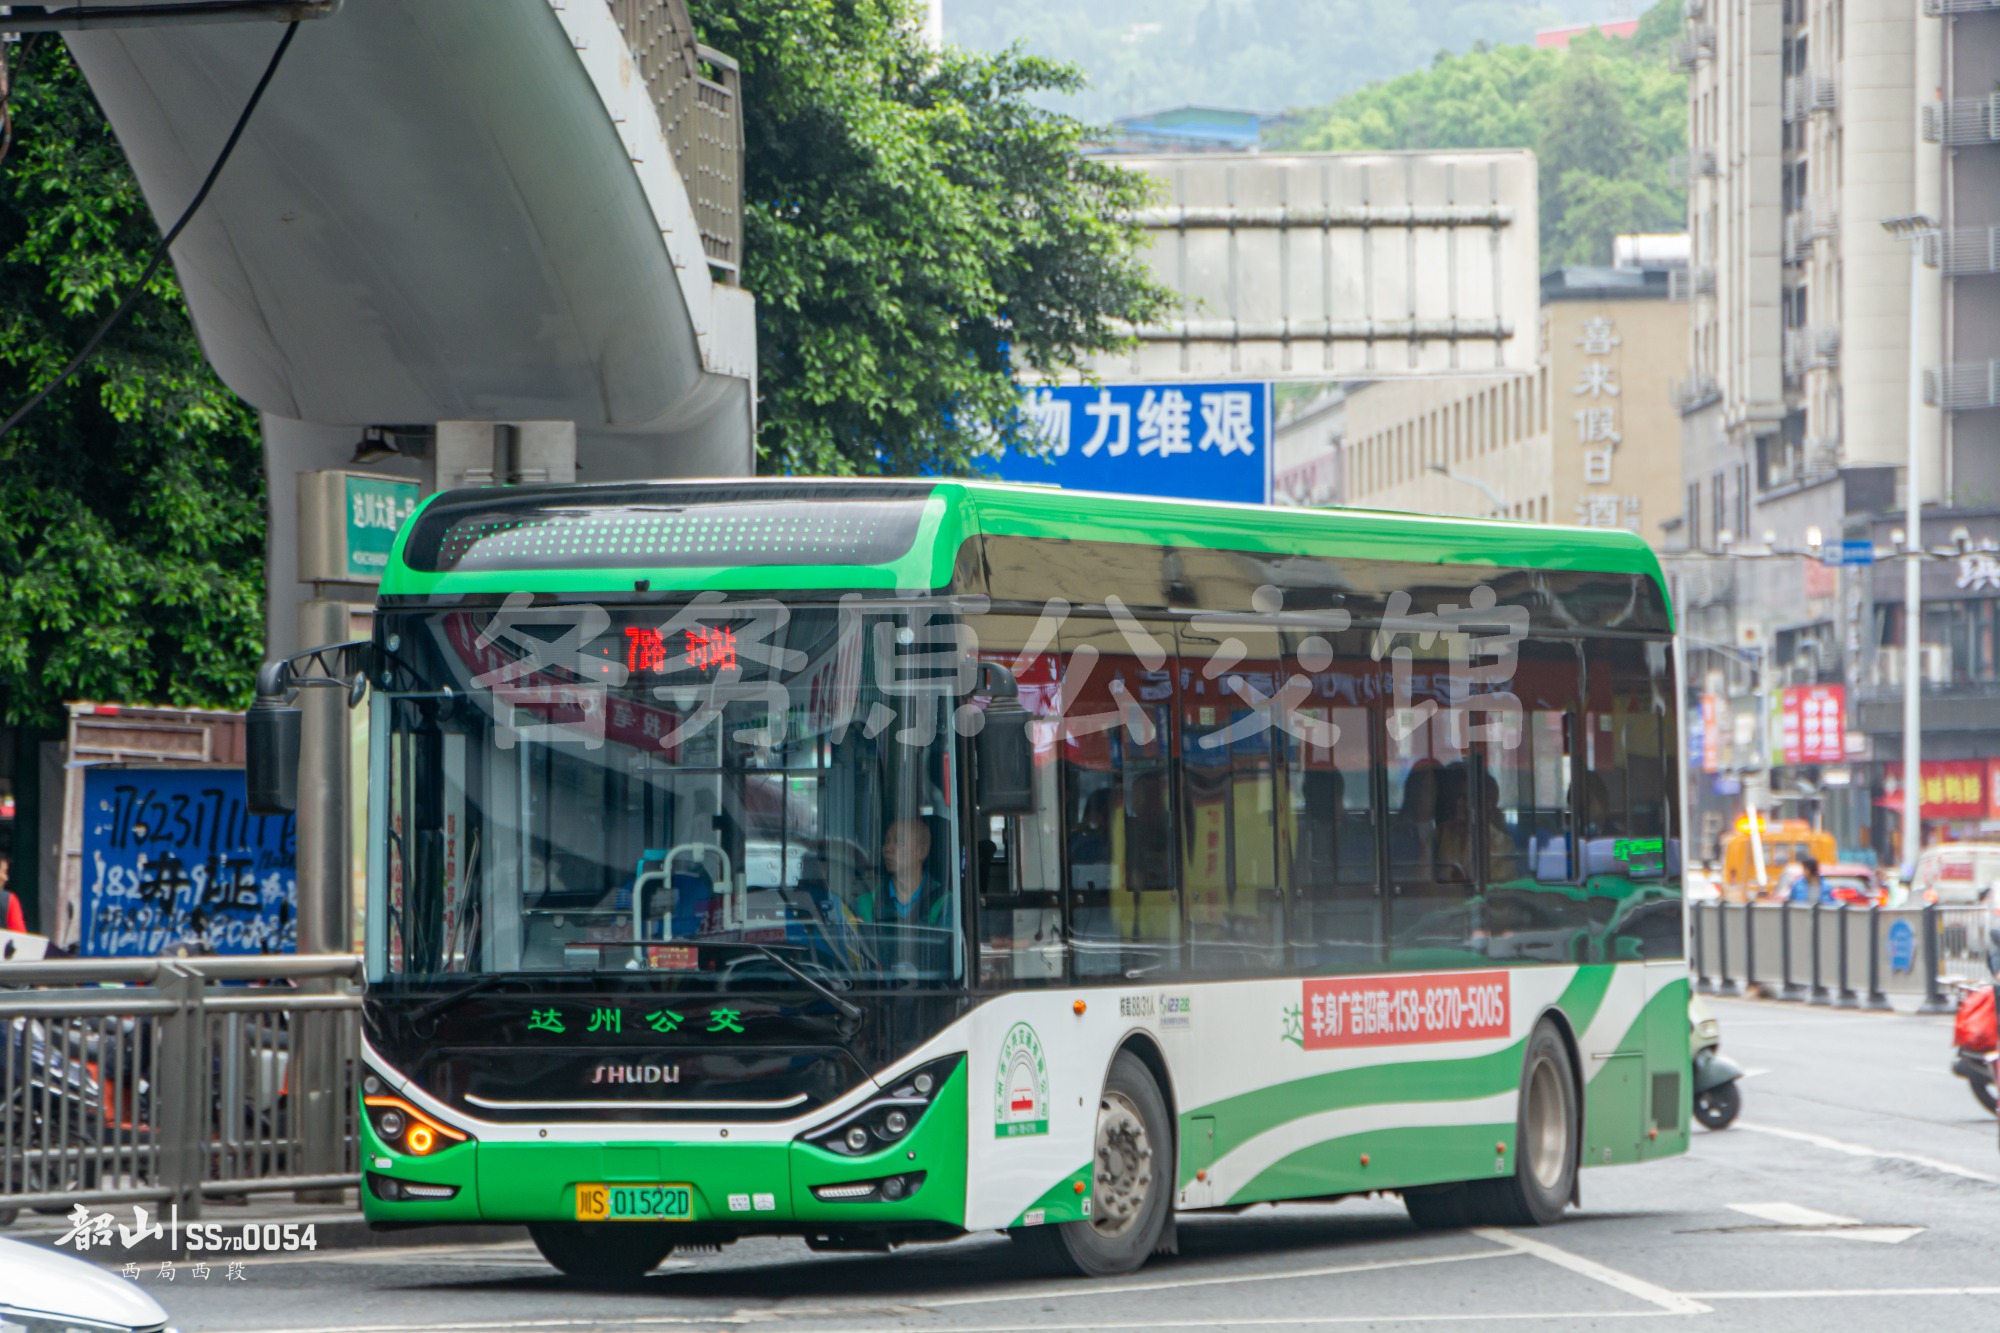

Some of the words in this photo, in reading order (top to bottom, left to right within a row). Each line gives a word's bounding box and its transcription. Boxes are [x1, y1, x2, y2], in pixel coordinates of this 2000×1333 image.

[528, 1008, 745, 1033] 达州公交
[591, 1065, 680, 1084] SHUDU
